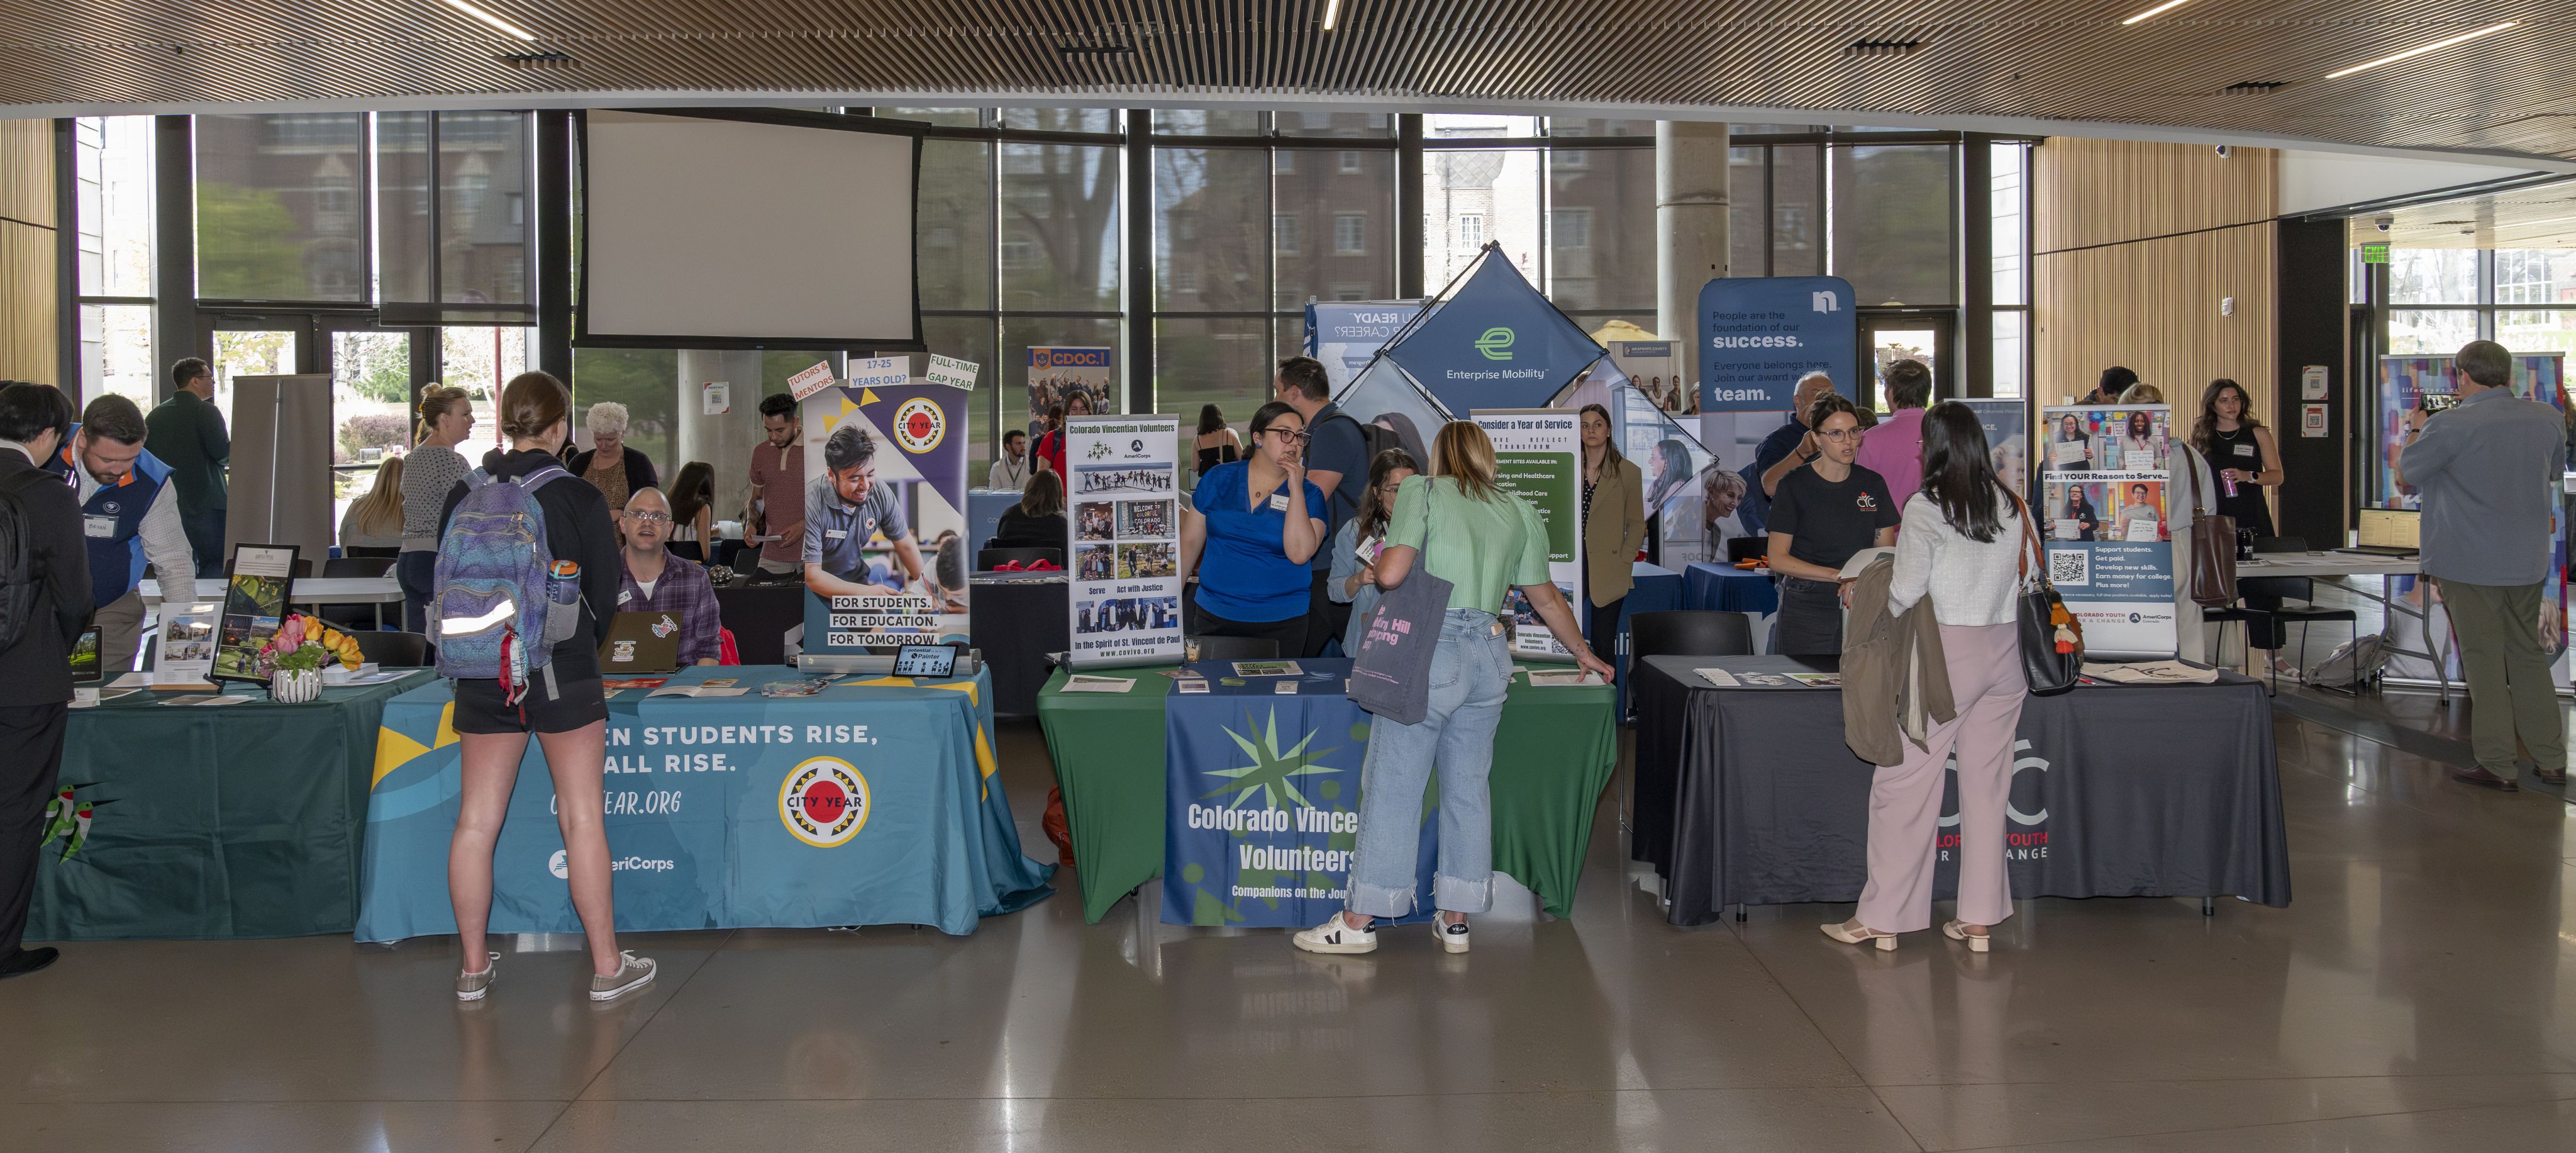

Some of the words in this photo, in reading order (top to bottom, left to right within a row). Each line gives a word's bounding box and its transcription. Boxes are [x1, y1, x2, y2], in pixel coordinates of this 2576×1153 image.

[2365, 246, 2386, 262] EXIT
[1713, 311, 1747, 321] People
[1768, 311, 1785, 320] the
[1713, 323, 1767, 332] foundation
[1770, 323, 1780, 331] of
[1713, 335, 1803, 348] success.
[867, 359, 891, 369] 17-25
[930, 354, 977, 374] FULL-TIME
[1714, 362, 1760, 372] Everyone
[1763, 360, 1804, 371] belongs
[1806, 360, 1831, 369] here.
[788, 366, 820, 386] TUTORS
[821, 362, 829, 370] &
[853, 377, 881, 386] YEARS
[883, 374, 907, 384] OLD?
[928, 372, 947, 382] GAP
[950, 377, 972, 389] YEAR
[1446, 369, 1499, 381] Enterprise
[1502, 369, 1544, 379] Mobility
[1714, 374, 1735, 382] Join
[1758, 373, 1788, 381] award
[795, 376, 833, 399] MENTORS
[1714, 387, 1771, 401] team.
[1070, 425, 1101, 434] Colorado
[1102, 425, 1138, 433] Vincentian
[1140, 424, 1174, 433] Volunteers
[1479, 420, 1509, 430] Consider
[1518, 420, 1533, 429] Year
[1535, 420, 1542, 429] of
[1544, 420, 1572, 429] Service
[1141, 584, 1163, 592] Justice
[835, 598, 859, 608] FOR
[863, 598, 930, 608] STUDENTS.
[833, 616, 857, 626] FOR
[861, 616, 937, 627] EDUCATION.
[1075, 596, 1178, 634] LOVE
[1391, 618, 1411, 634] Hill
[830, 635, 854, 644] FOR
[860, 634, 938, 645] TOMORROW.
[1075, 642, 1082, 650] In
[1083, 640, 1094, 649] the
[1095, 639, 1113, 649] Spirit
[1114, 638, 1121, 647] of
[1122, 638, 1130, 647] St.
[1131, 637, 1155, 646] Vincent
[1157, 636, 1165, 644] de
[1167, 635, 1180, 643] Paul
[1100, 647, 1155, 657] www.covivo.org
[643, 725, 794, 746] STUDENTS
[806, 725, 878, 745] RISE,
[604, 755, 652, 774] ALL
[665, 754, 736, 773] RISE.
[787, 796, 818, 808] CITY
[825, 796, 862, 808] YEAR
[1188, 803, 1289, 832] Colorado
[1296, 806, 1360, 833] Vince
[2006, 847, 2047, 860] ANGE
[612, 856, 674, 872] eriCorps
[1232, 885, 1292, 898] Companions
[1294, 888, 1307, 898] on
[1309, 887, 1325, 899] the
[1328, 888, 1346, 900] Jou
